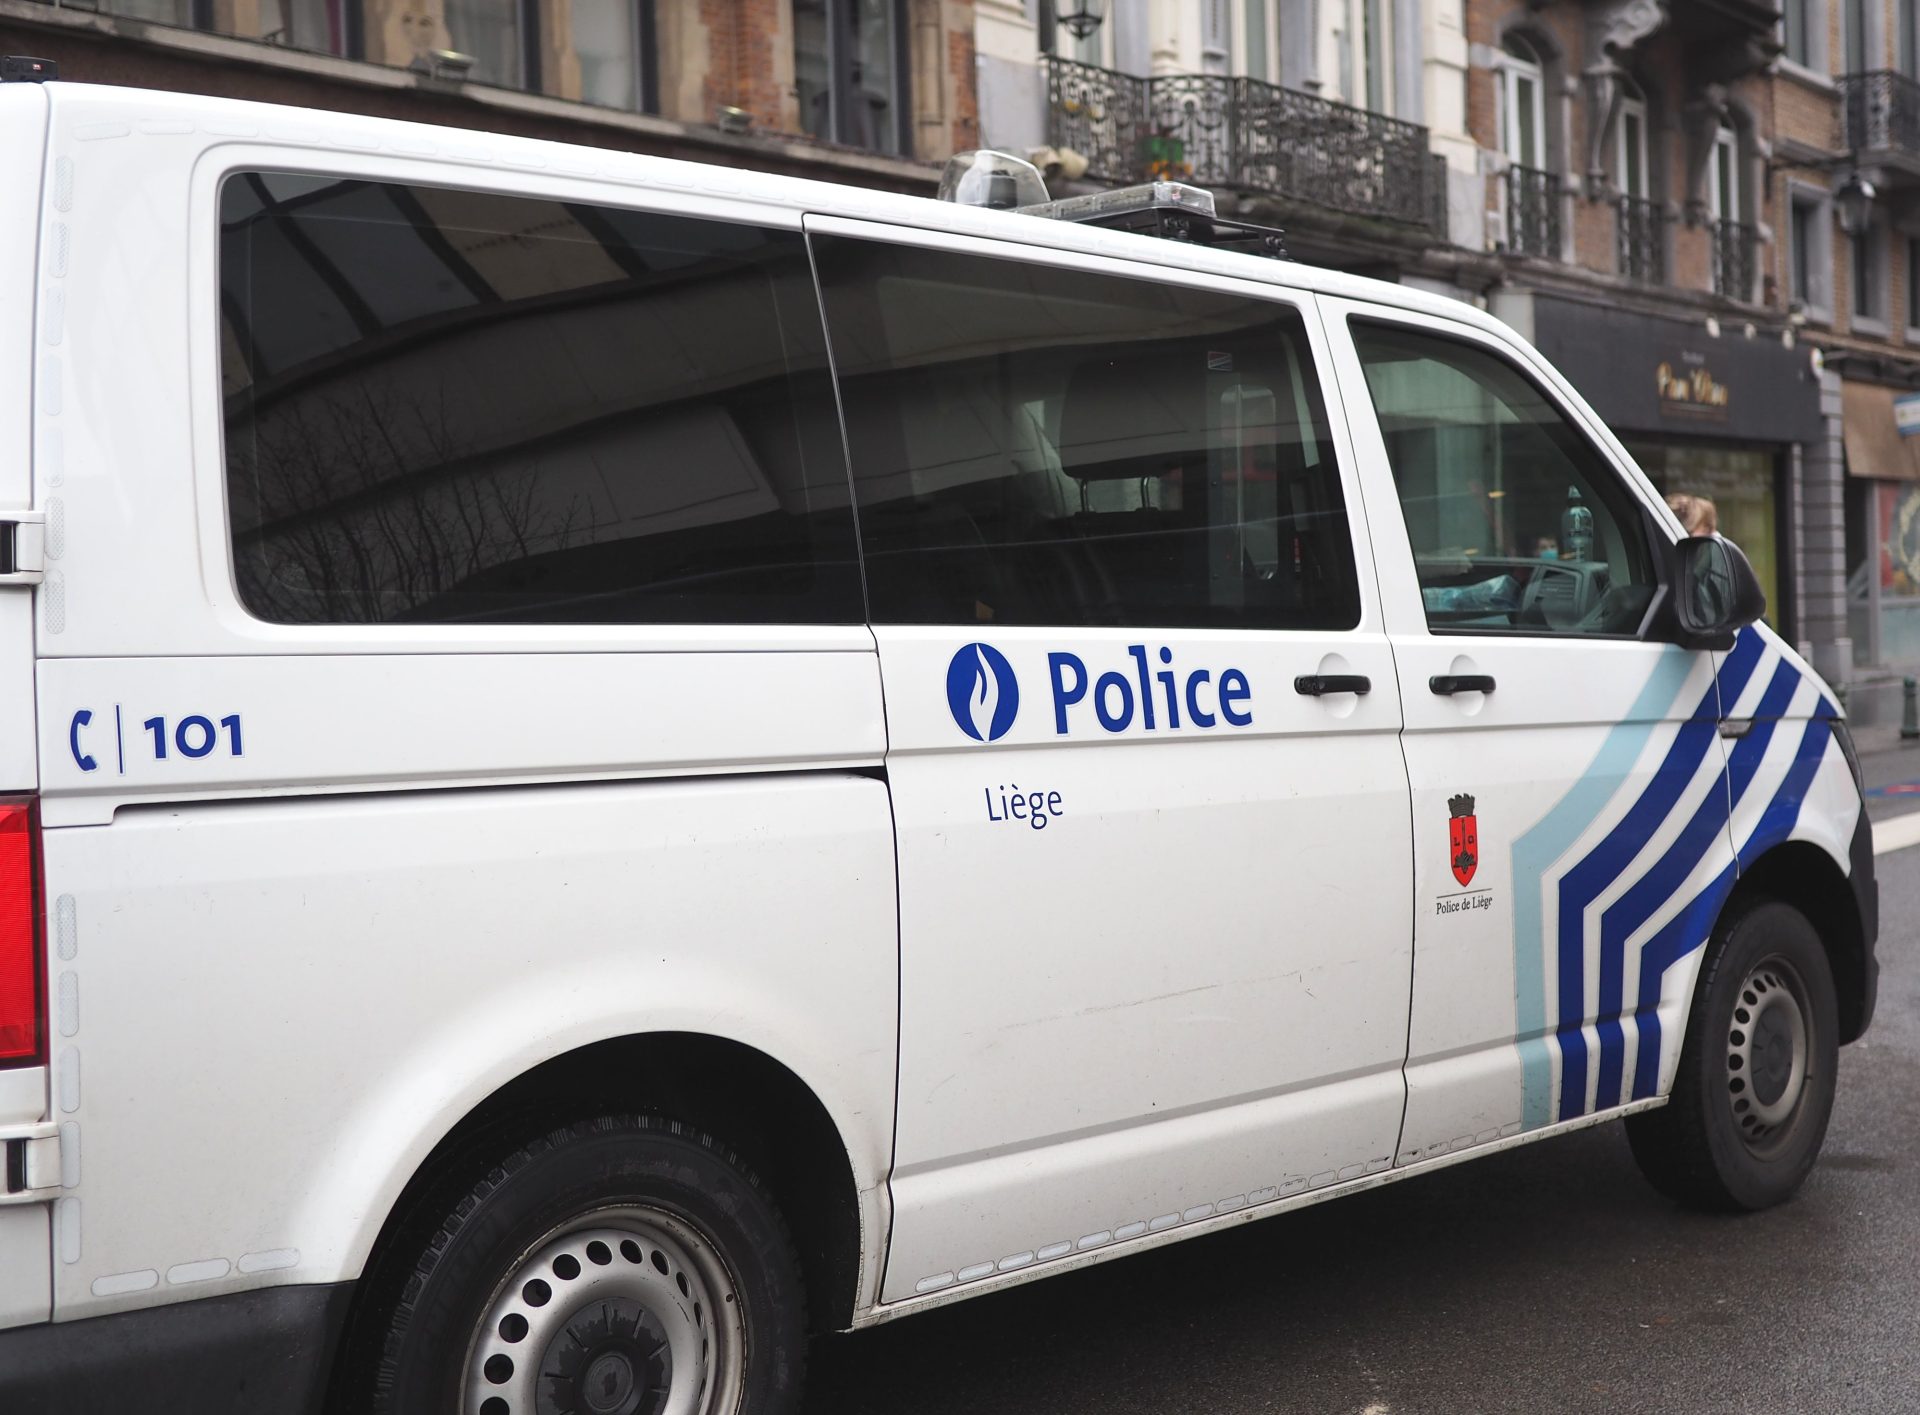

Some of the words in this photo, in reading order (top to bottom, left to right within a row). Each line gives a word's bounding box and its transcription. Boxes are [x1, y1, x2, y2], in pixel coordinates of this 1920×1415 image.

[1048, 645, 1253, 735] Police
[143, 713, 244, 760] 101
[985, 783, 1063, 830] Liège
[1436, 900, 1460, 915] Police
[1461, 898, 1471, 911] de
